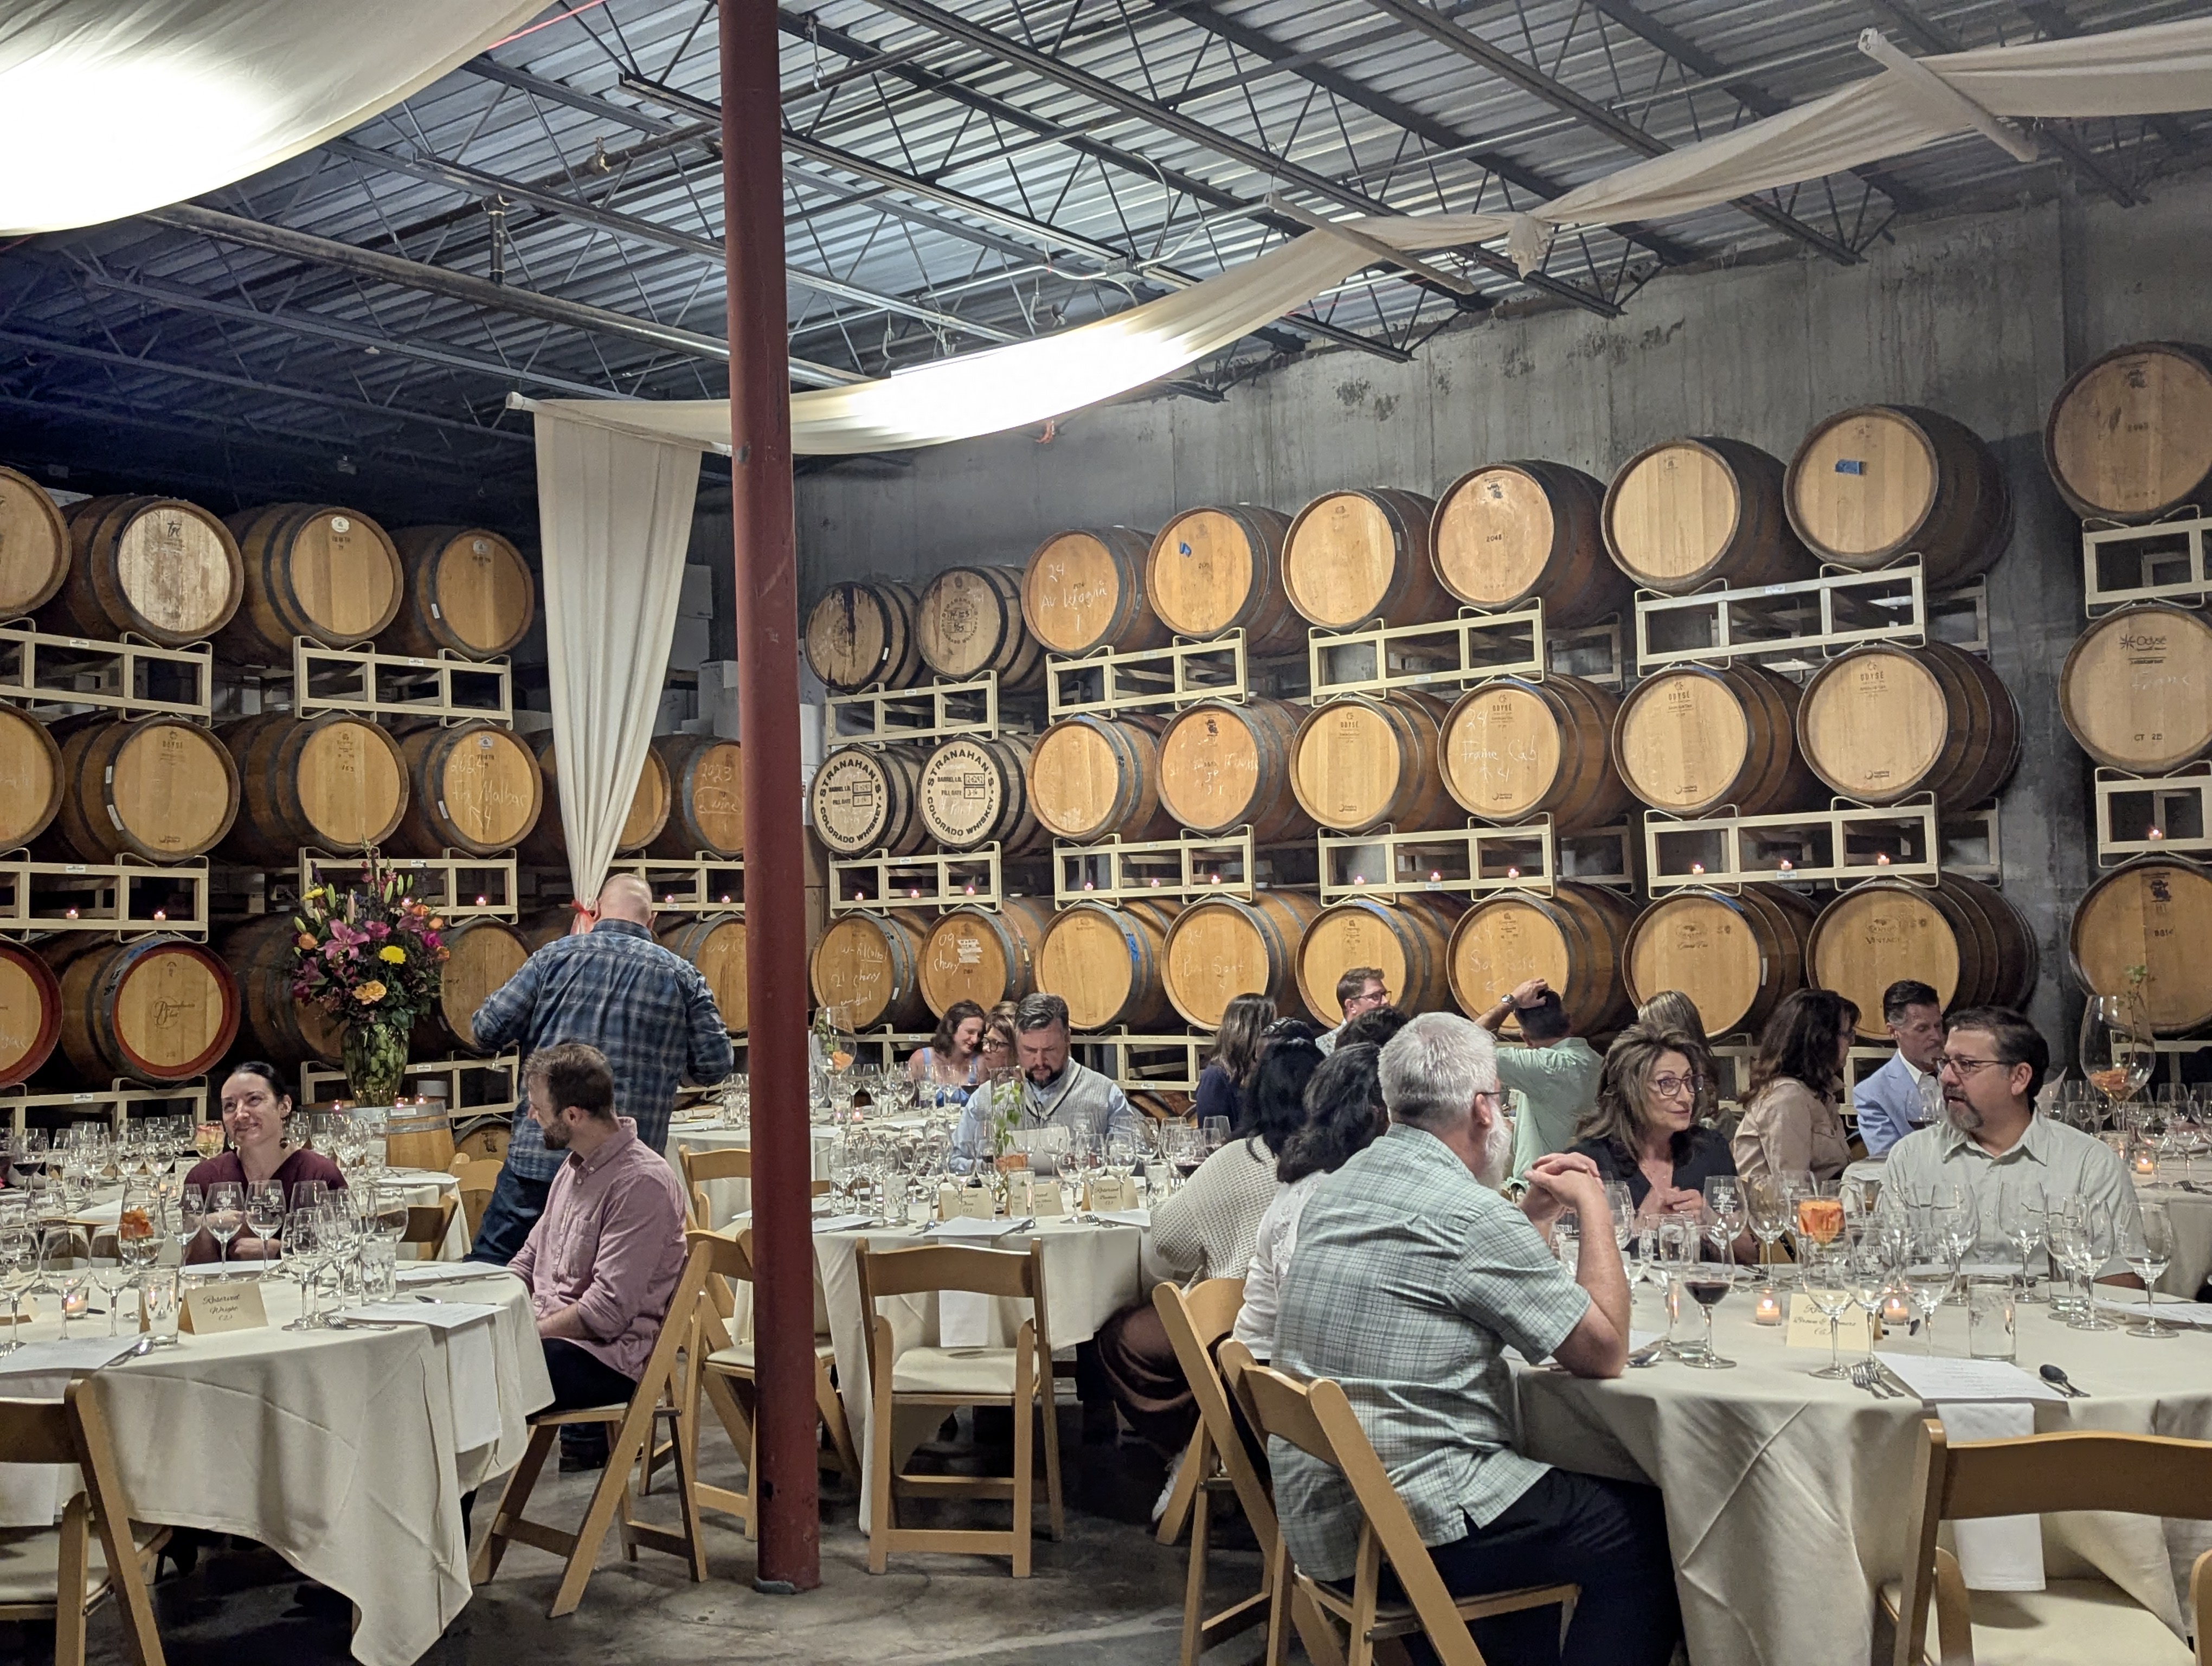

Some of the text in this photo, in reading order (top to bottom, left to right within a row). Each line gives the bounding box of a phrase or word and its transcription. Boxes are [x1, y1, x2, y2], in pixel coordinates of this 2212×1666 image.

[1049, 562, 1064, 582] 24
[820, 759, 882, 798] STRANAHAN'S
[928, 749, 994, 787] STRANAHAN'S
[820, 803, 882, 843] COLORADO WHISKEY
[928, 797, 994, 836] COLORADO WHISKEY
[203, 1294, 240, 1305] Reserved
